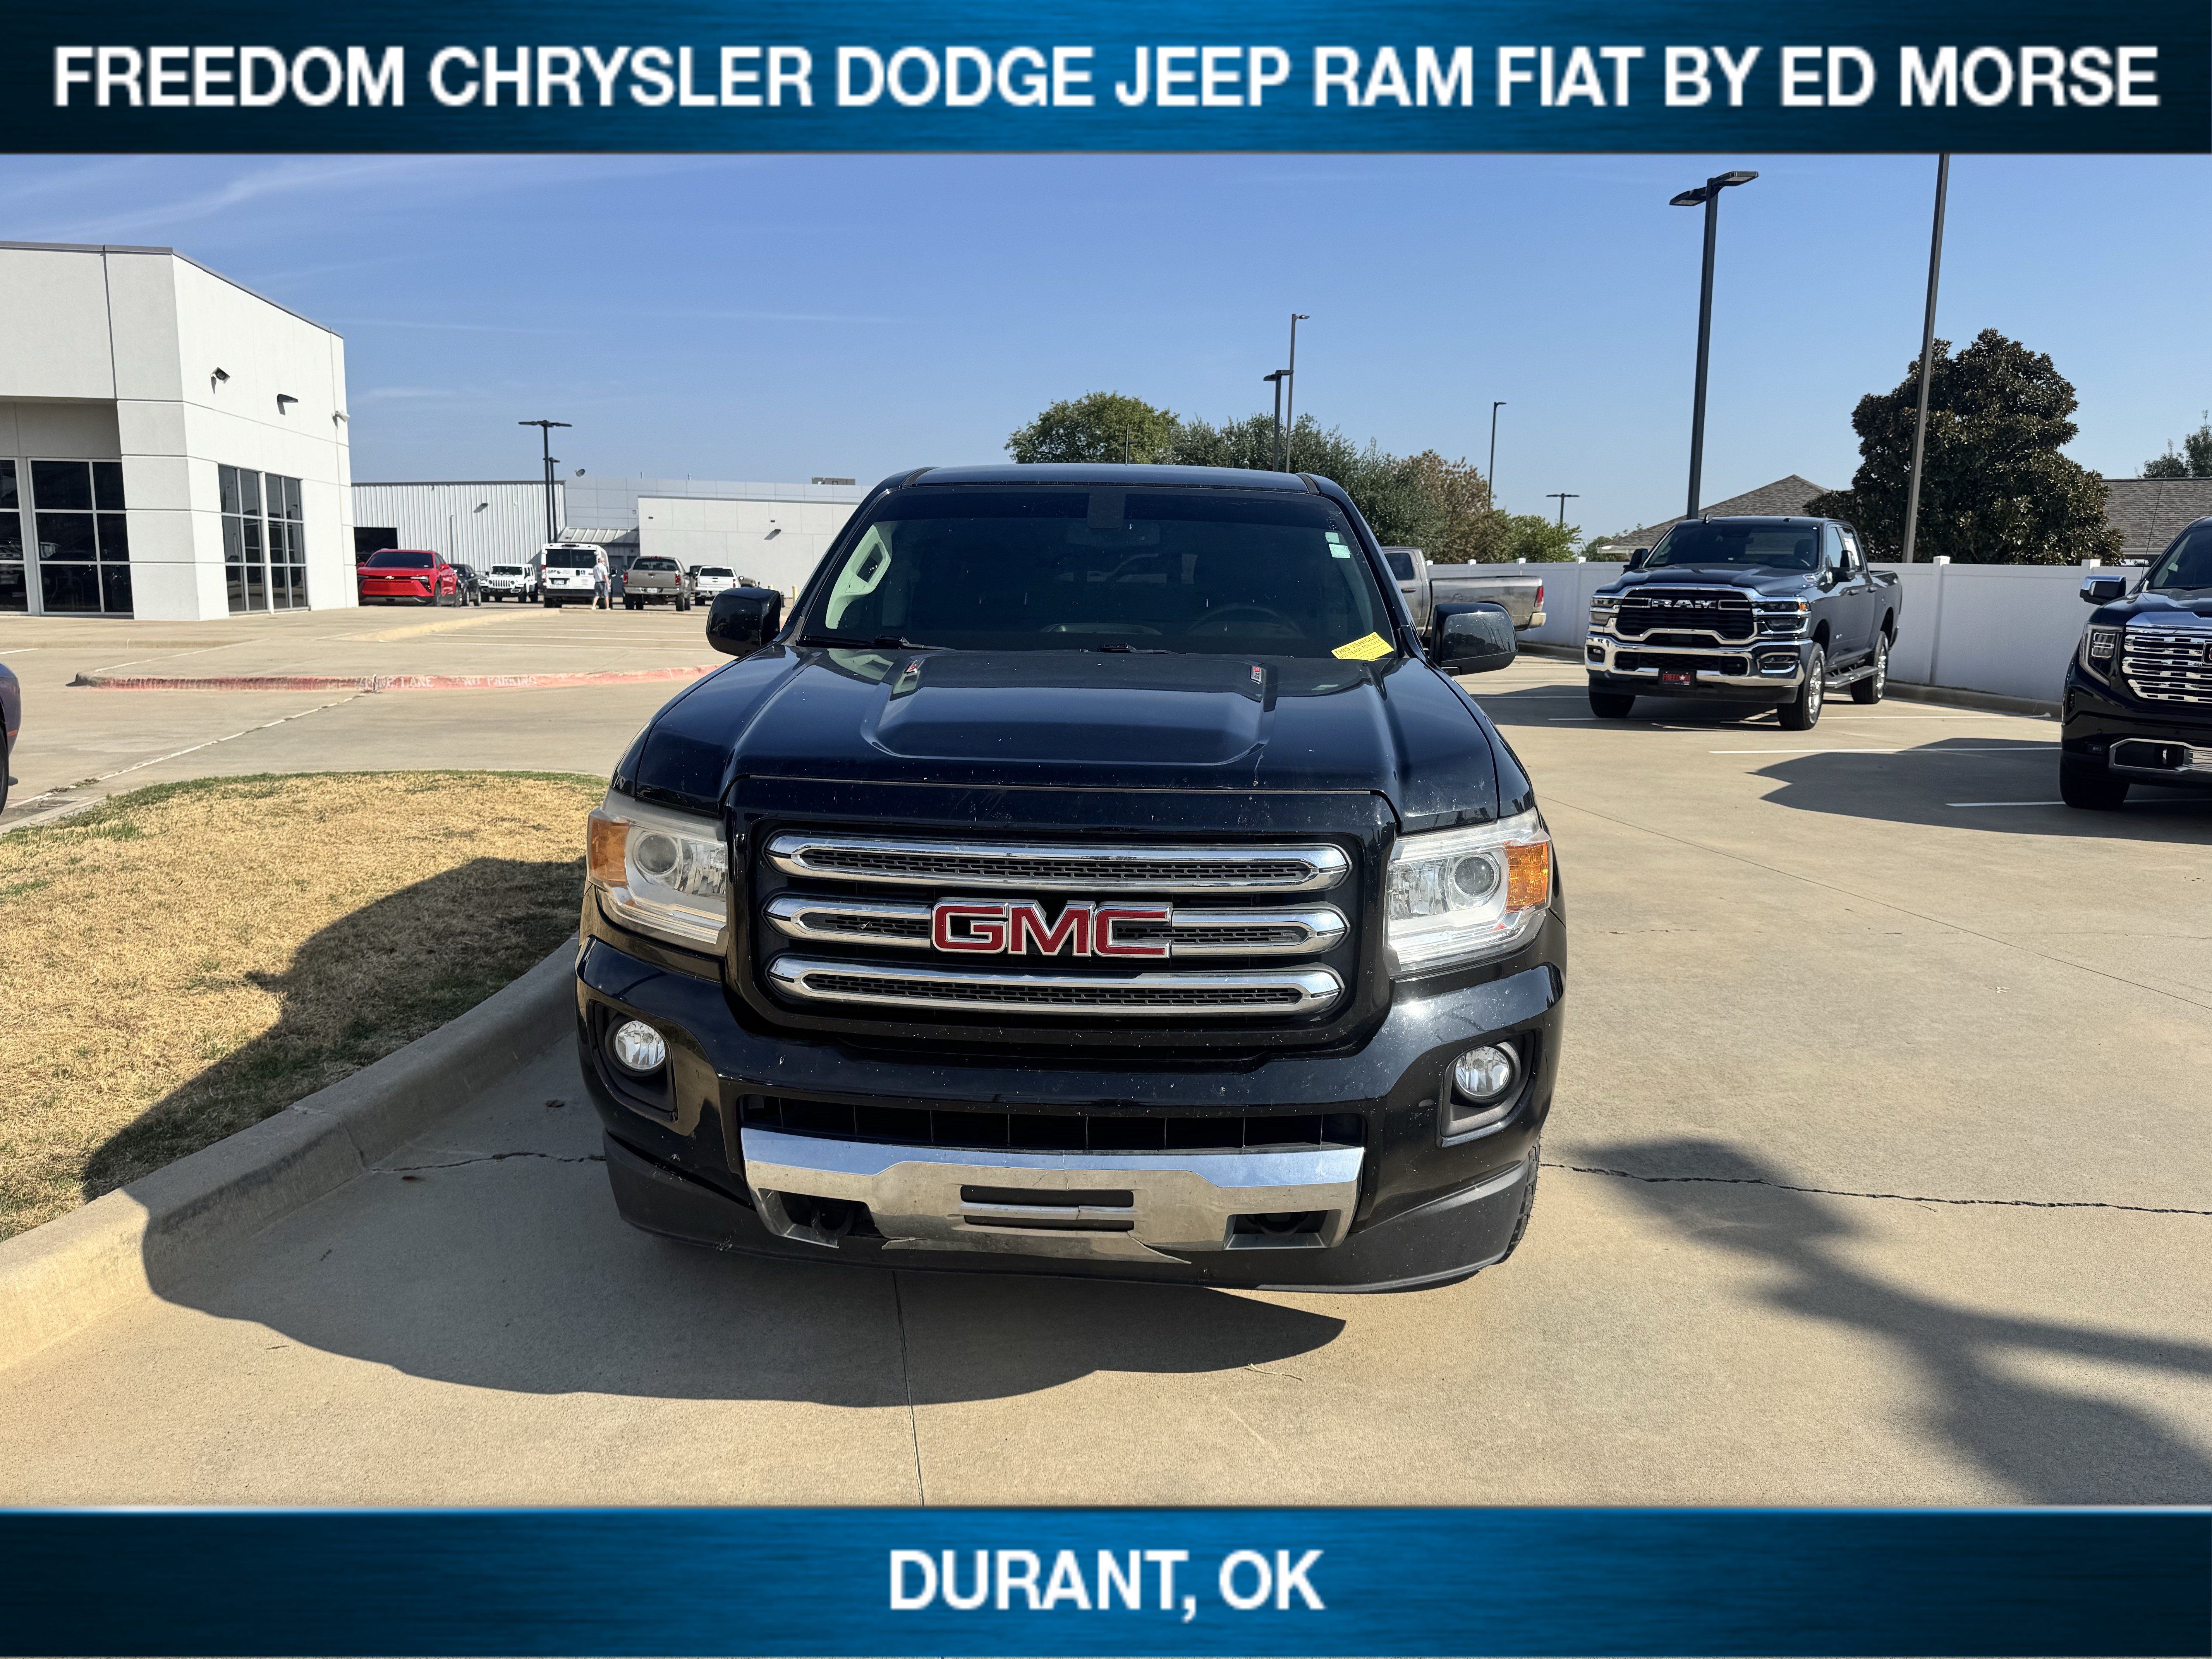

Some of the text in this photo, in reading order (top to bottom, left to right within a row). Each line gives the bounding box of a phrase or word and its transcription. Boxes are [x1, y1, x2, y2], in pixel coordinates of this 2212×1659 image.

[1651, 599, 1717, 609] RAM
[1334, 647, 1350, 655] THIS
[1350, 634, 1378, 647] VEHICLE
[1348, 647, 1362, 655] READY
[931, 897, 1173, 958] GMC
